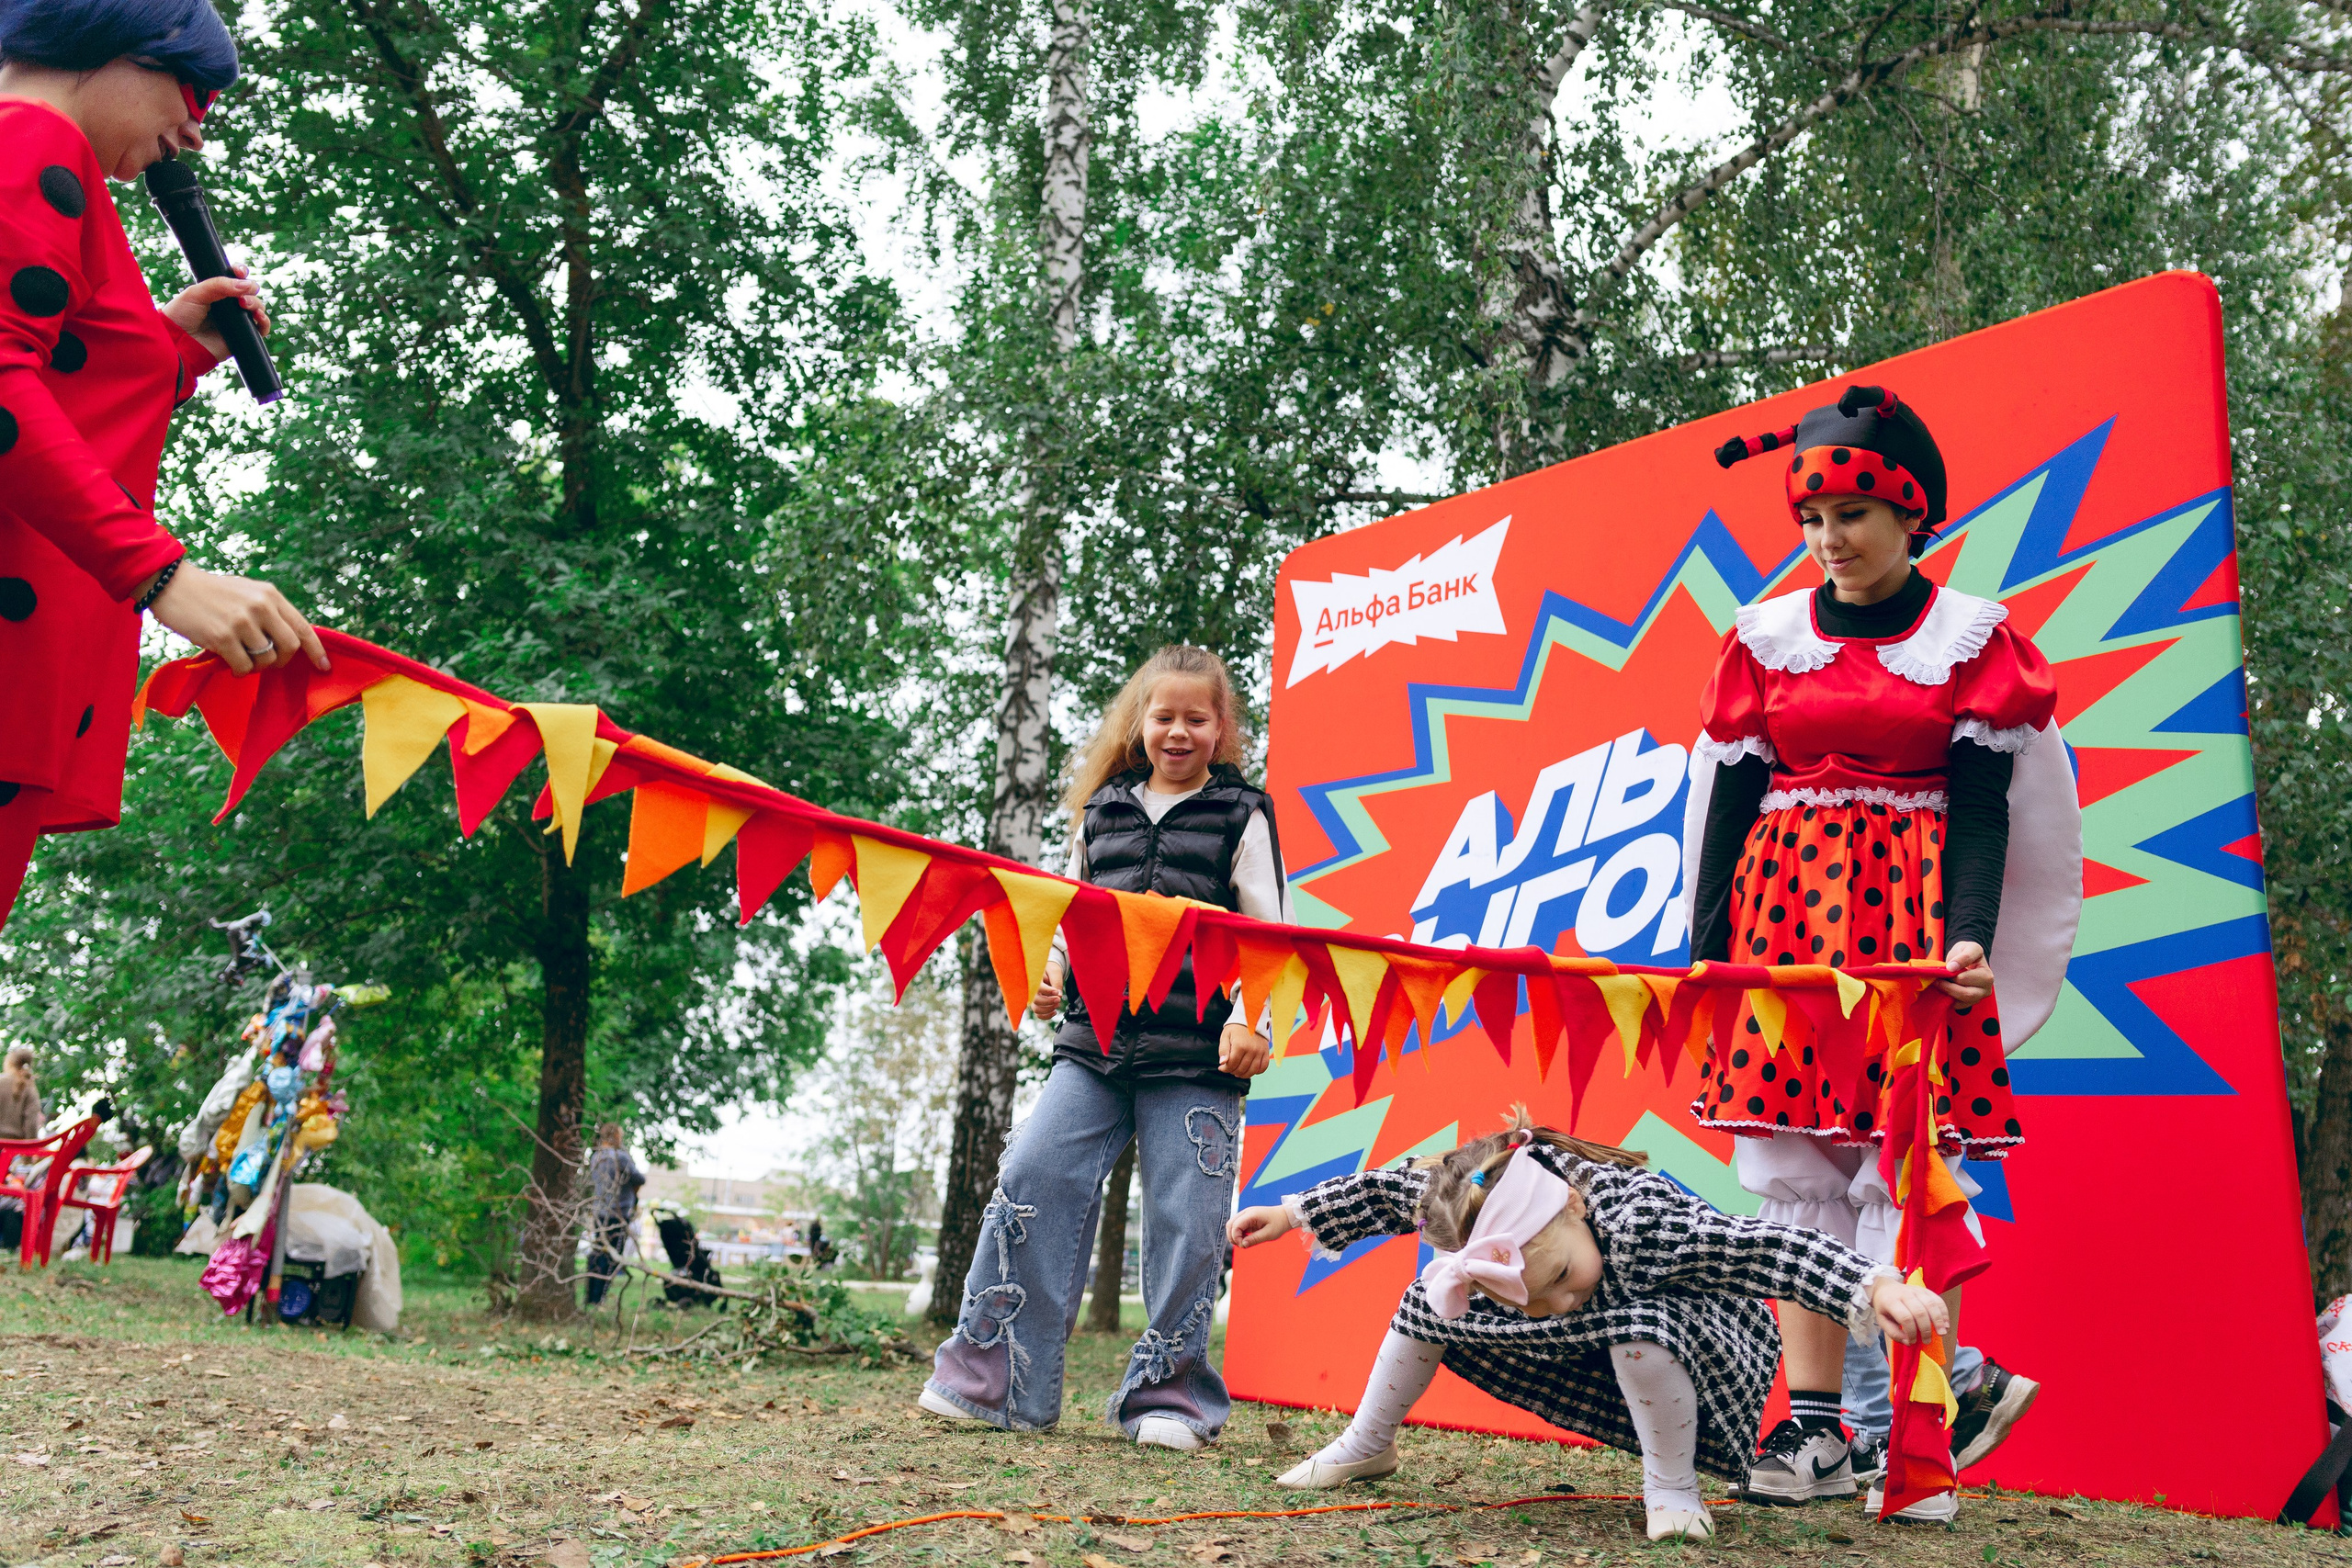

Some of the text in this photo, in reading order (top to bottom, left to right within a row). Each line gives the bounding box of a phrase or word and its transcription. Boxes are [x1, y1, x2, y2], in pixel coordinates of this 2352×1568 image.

[1314, 572, 1478, 649] Альфа Банк
[1409, 726, 1698, 915] АЛЬ
